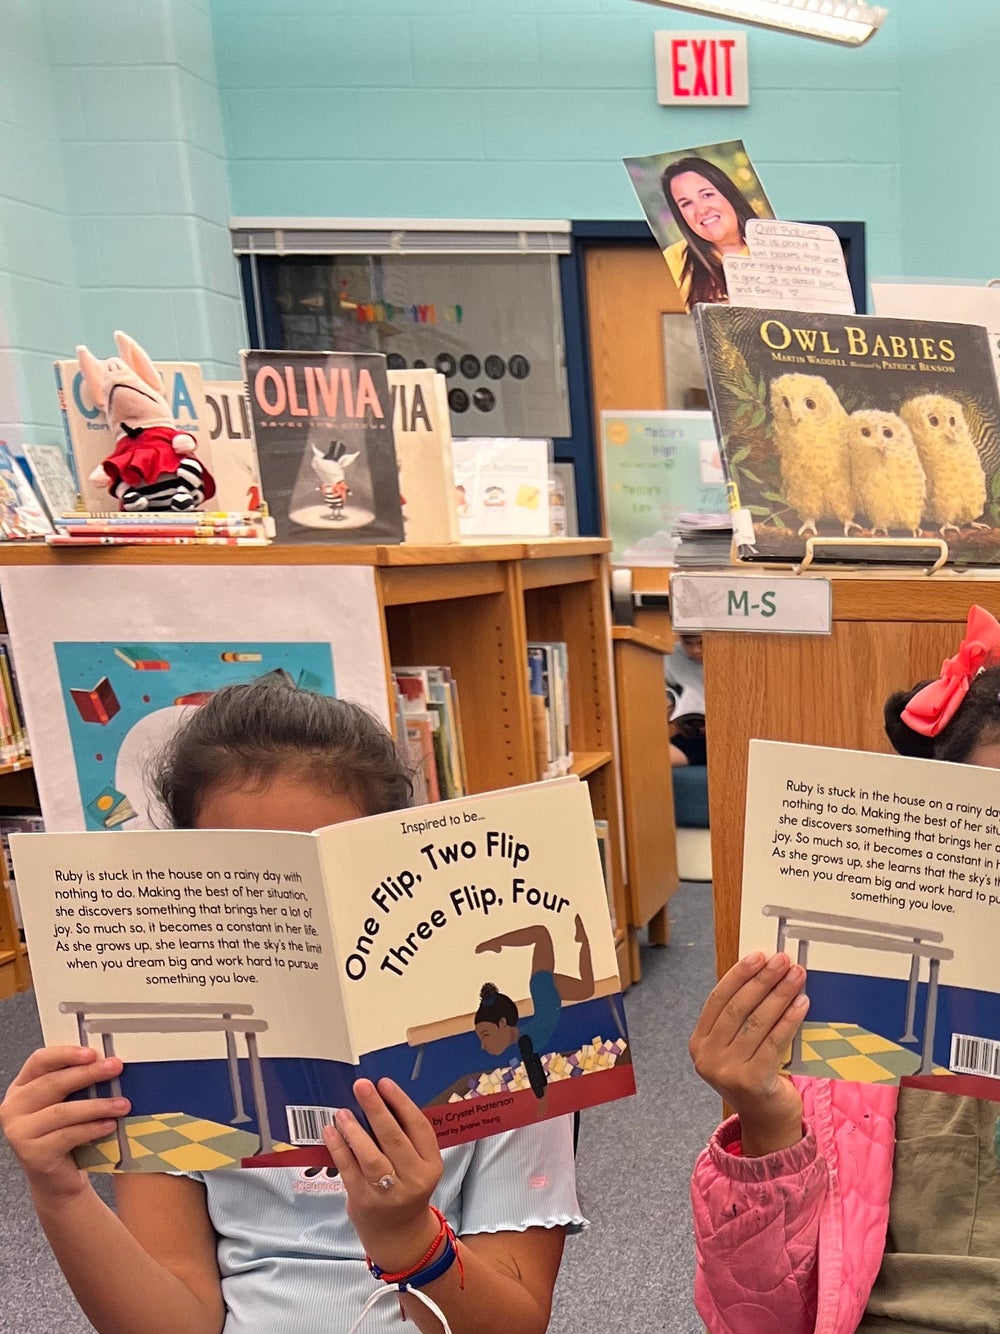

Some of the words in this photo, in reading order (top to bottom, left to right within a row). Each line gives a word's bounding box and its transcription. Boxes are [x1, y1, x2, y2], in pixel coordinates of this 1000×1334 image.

[671, 39, 736, 97] EXIT
[760, 320, 839, 354] OWL
[844, 326, 956, 361] BABIES
[772, 352, 806, 364] MARTIN
[807, 355, 847, 368] WADDELL
[882, 360, 917, 372] PATRICK
[919, 362, 956, 374] BENSON
[255, 365, 384, 418] OLIVIA
[728, 590, 776, 617] M-S
[782, 798, 824, 815] nothing
[826, 802, 839, 813] to
[841, 804, 858, 816] do.
[861, 806, 902, 826] Making
[902, 810, 921, 824] the
[924, 814, 947, 827] best
[950, 817, 962, 829] of
[964, 819, 982, 832] her
[786, 780, 814, 796] Ruby
[817, 784, 824, 795] is
[828, 786, 856, 798] stuck
[859, 789, 869, 801] in
[872, 790, 890, 802] the
[893, 792, 926, 807] house
[929, 800, 944, 810] on
[944, 802, 953, 813] a
[956, 803, 982, 818] rainy
[772, 830, 792, 845] joy.
[796, 832, 810, 844] So
[813, 836, 843, 848] much
[846, 840, 860, 851] so,
[864, 840, 870, 851] it
[874, 841, 922, 858] becomes
[926, 851, 933, 863] a
[936, 851, 982, 867] constant
[984, 857, 993, 869] in
[778, 814, 798, 826] she
[801, 816, 853, 832] discovers
[855, 825, 912, 843] something
[913, 829, 936, 843] that
[938, 832, 972, 850] brings
[974, 838, 992, 851] her
[772, 846, 786, 858] As
[789, 848, 808, 860] she
[811, 854, 844, 865] grows
[847, 858, 863, 870] up,
[866, 858, 885, 870] she
[888, 860, 921, 875] learns
[924, 865, 946, 878] that
[948, 868, 966, 881] the
[969, 872, 991, 887] sky's
[345, 917, 380, 981] One
[371, 870, 422, 914] Flip,
[420, 840, 477, 870] Two
[486, 831, 530, 869] Flip
[380, 909, 447, 976] Three
[449, 885, 503, 916] Flip,
[512, 878, 570, 914] Four
[433, 1117, 443, 1127] by
[445, 1107, 475, 1122] Crystel
[476, 1097, 514, 1112] Patterson
